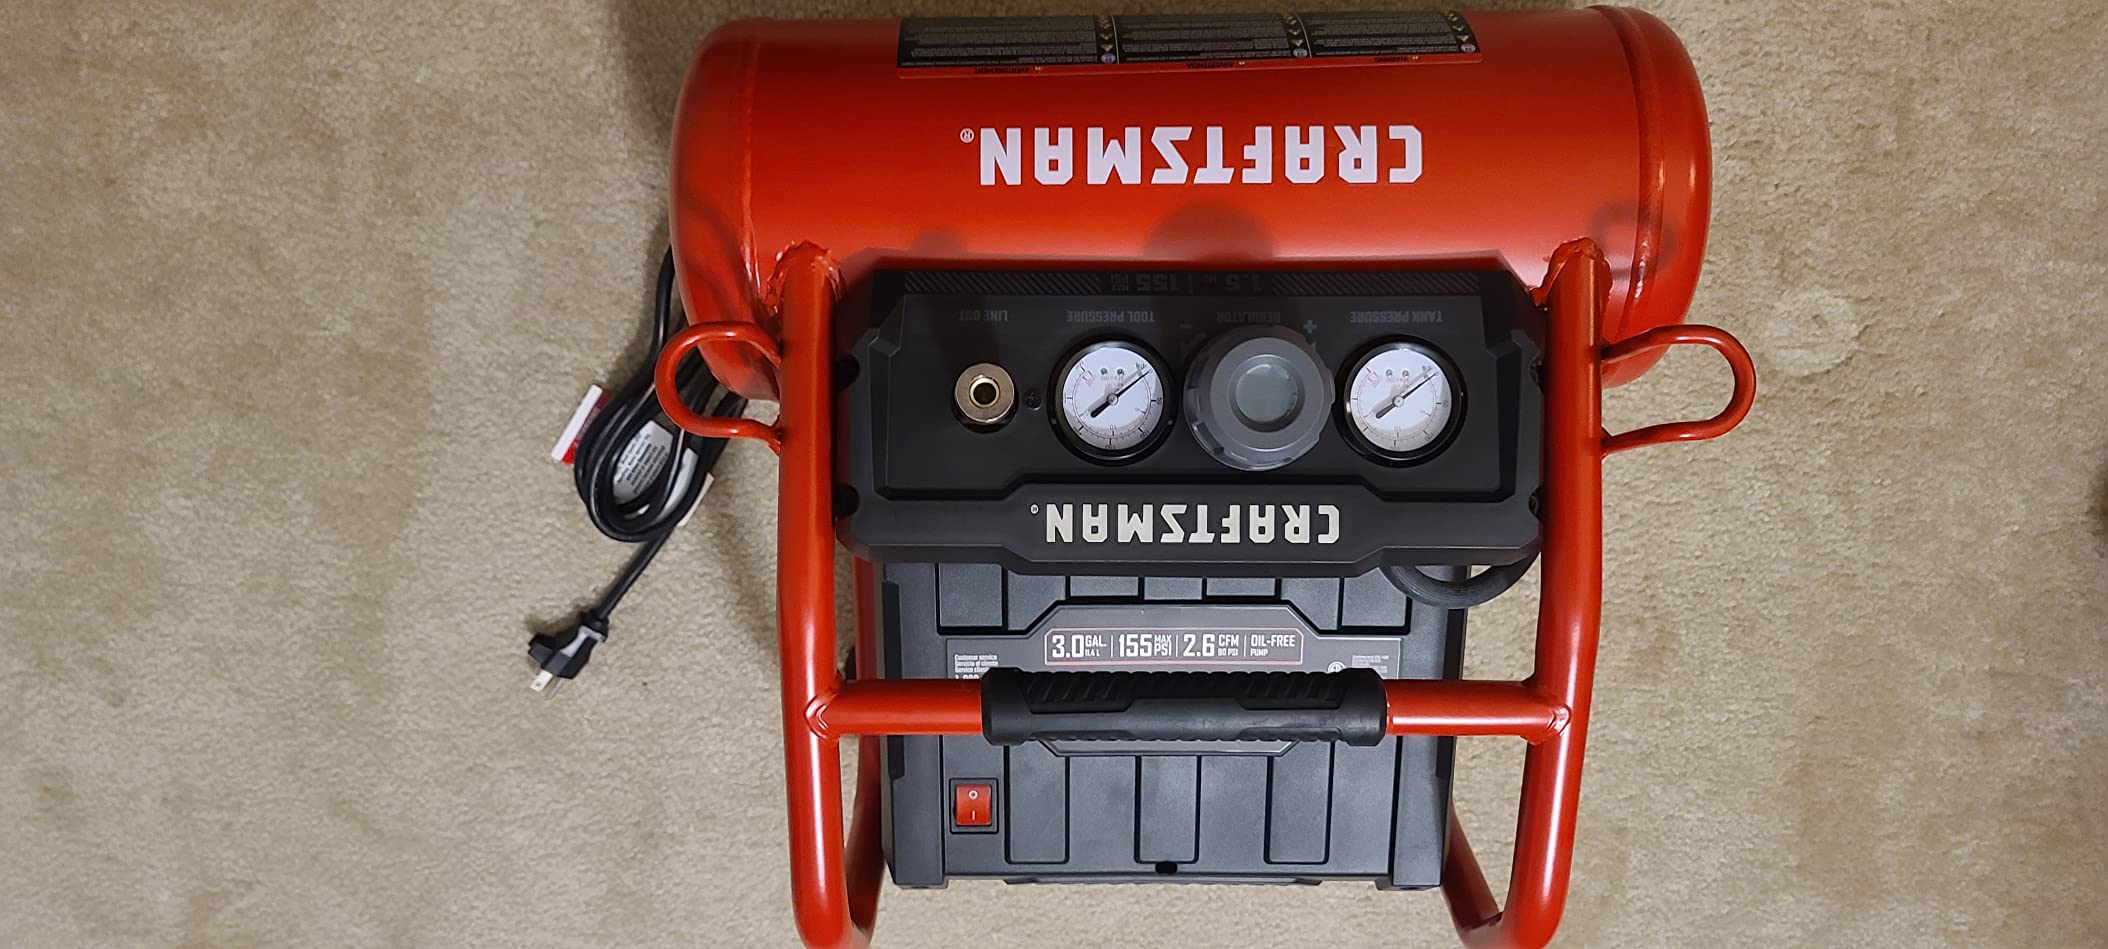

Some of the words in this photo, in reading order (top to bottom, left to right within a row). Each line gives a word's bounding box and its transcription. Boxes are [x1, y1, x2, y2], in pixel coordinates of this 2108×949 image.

[984, 310, 1008, 321] LINE
[1065, 310, 1125, 322] PRESSURE
[1127, 310, 1155, 322] TOOL
[1350, 311, 1410, 323] PRESSURE
[1412, 310, 1443, 322] TANK
[1051, 634, 1084, 658] 3.0
[1085, 636, 1107, 647] GAL.
[1119, 634, 1153, 657] 155
[1154, 635, 1172, 643] MAX
[1183, 633, 1215, 657] 2.6
[1218, 634, 1239, 646] CFM
[1251, 634, 1296, 647] OIL-FREE
[1154, 644, 1172, 656] PSI
[1250, 648, 1268, 656] PUMP
